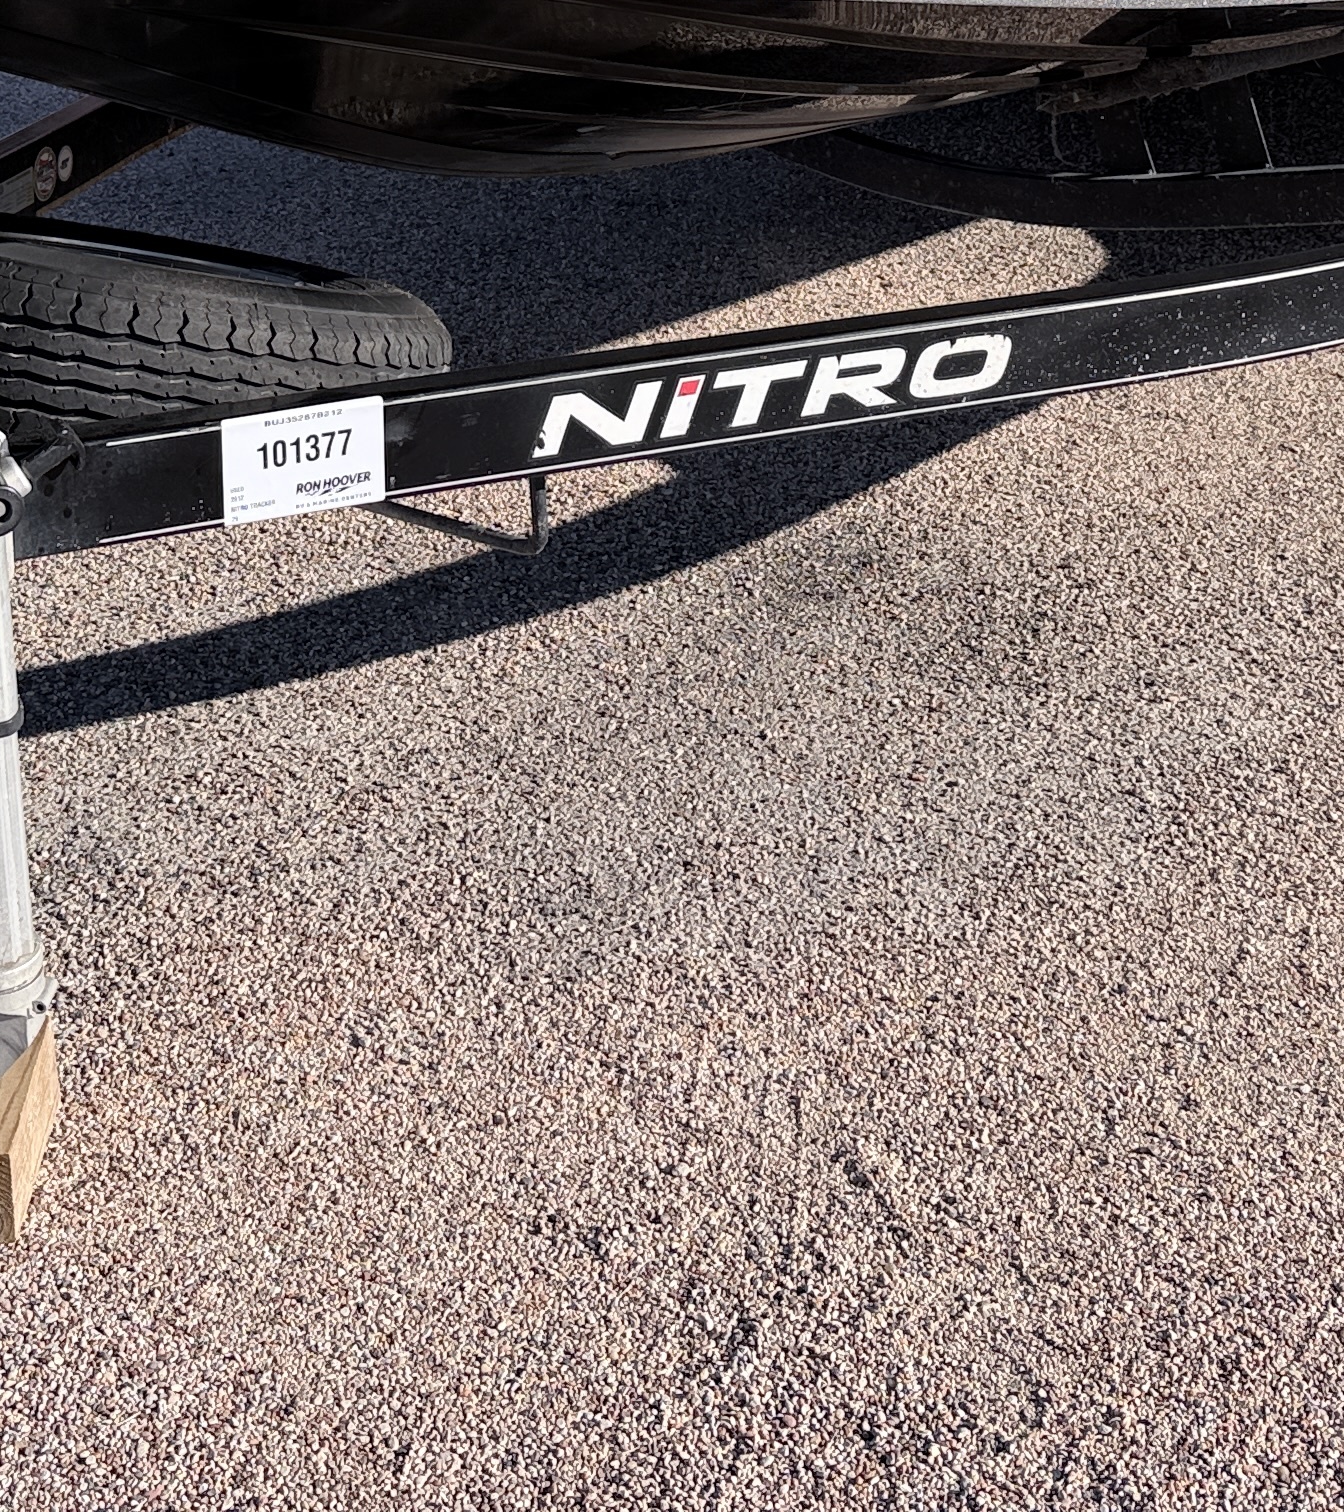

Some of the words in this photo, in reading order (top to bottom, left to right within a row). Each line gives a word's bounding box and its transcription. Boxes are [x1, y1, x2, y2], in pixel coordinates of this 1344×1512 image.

[530, 333, 1013, 460] NITRO
[256, 428, 353, 470] 101377
[296, 479, 322, 495] RON
[323, 471, 371, 489] HOOVER
